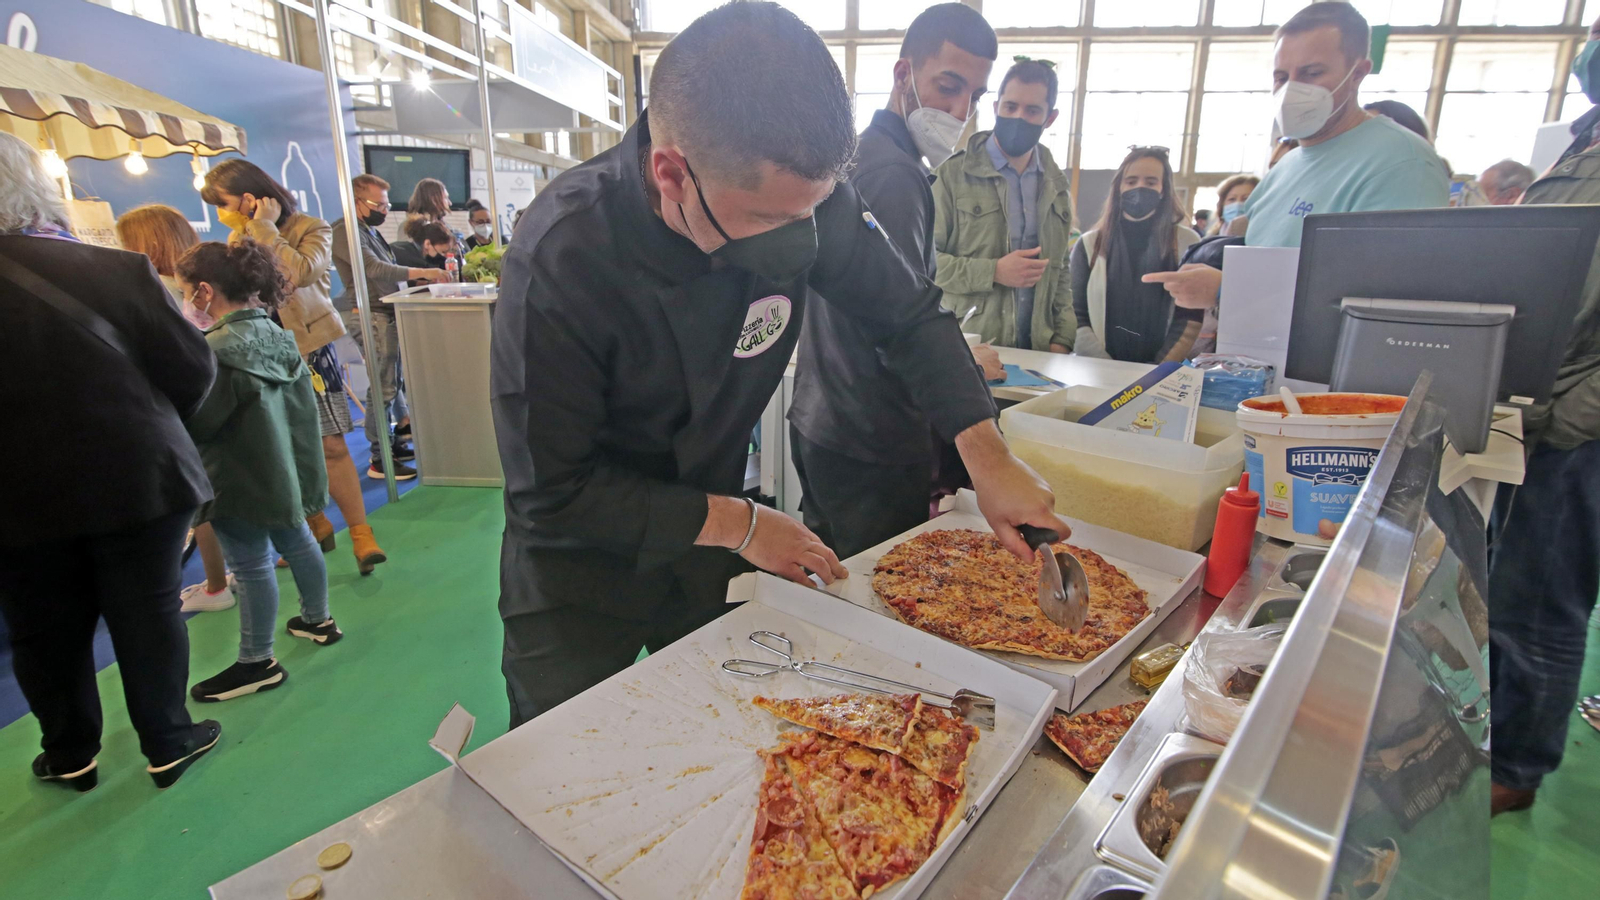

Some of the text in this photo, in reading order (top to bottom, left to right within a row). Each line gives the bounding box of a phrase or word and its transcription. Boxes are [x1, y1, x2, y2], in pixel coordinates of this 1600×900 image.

[1288, 196, 1314, 218] Lee
[741, 316, 764, 333] izzería
[1389, 339, 1450, 349] ORDERMAN
[1110, 385, 1143, 410] makro
[1291, 451, 1378, 468] HELLMANN'S
